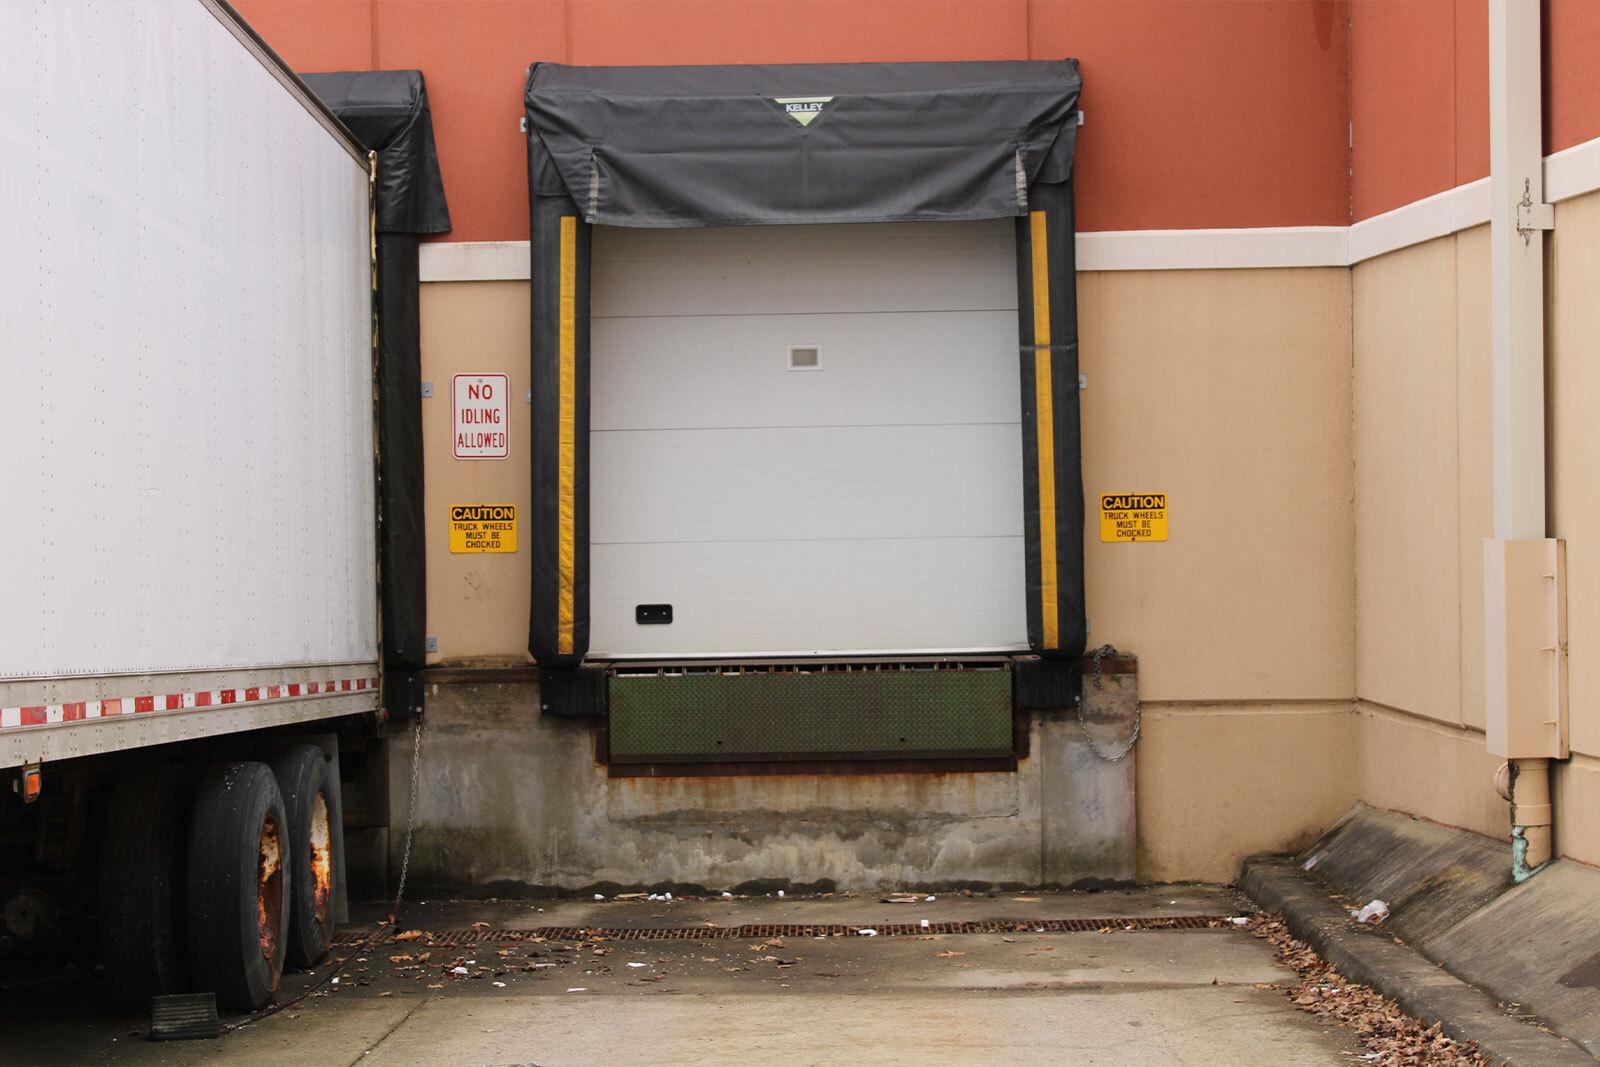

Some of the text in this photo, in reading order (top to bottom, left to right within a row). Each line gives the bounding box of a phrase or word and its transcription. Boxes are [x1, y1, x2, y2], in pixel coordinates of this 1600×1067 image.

[785, 103, 823, 111] KELLEY
[468, 384, 493, 400] NO
[461, 408, 500, 424] IDLING
[457, 432, 505, 448] ALLOWED
[1103, 496, 1164, 509] CAUTION
[452, 508, 514, 520] CAUTION
[1104, 511, 1163, 520] TRUCK WHEELS
[1141, 520, 1151, 528] BE
[491, 531, 501, 539] BE
[1116, 529, 1152, 537] CHOCKED
